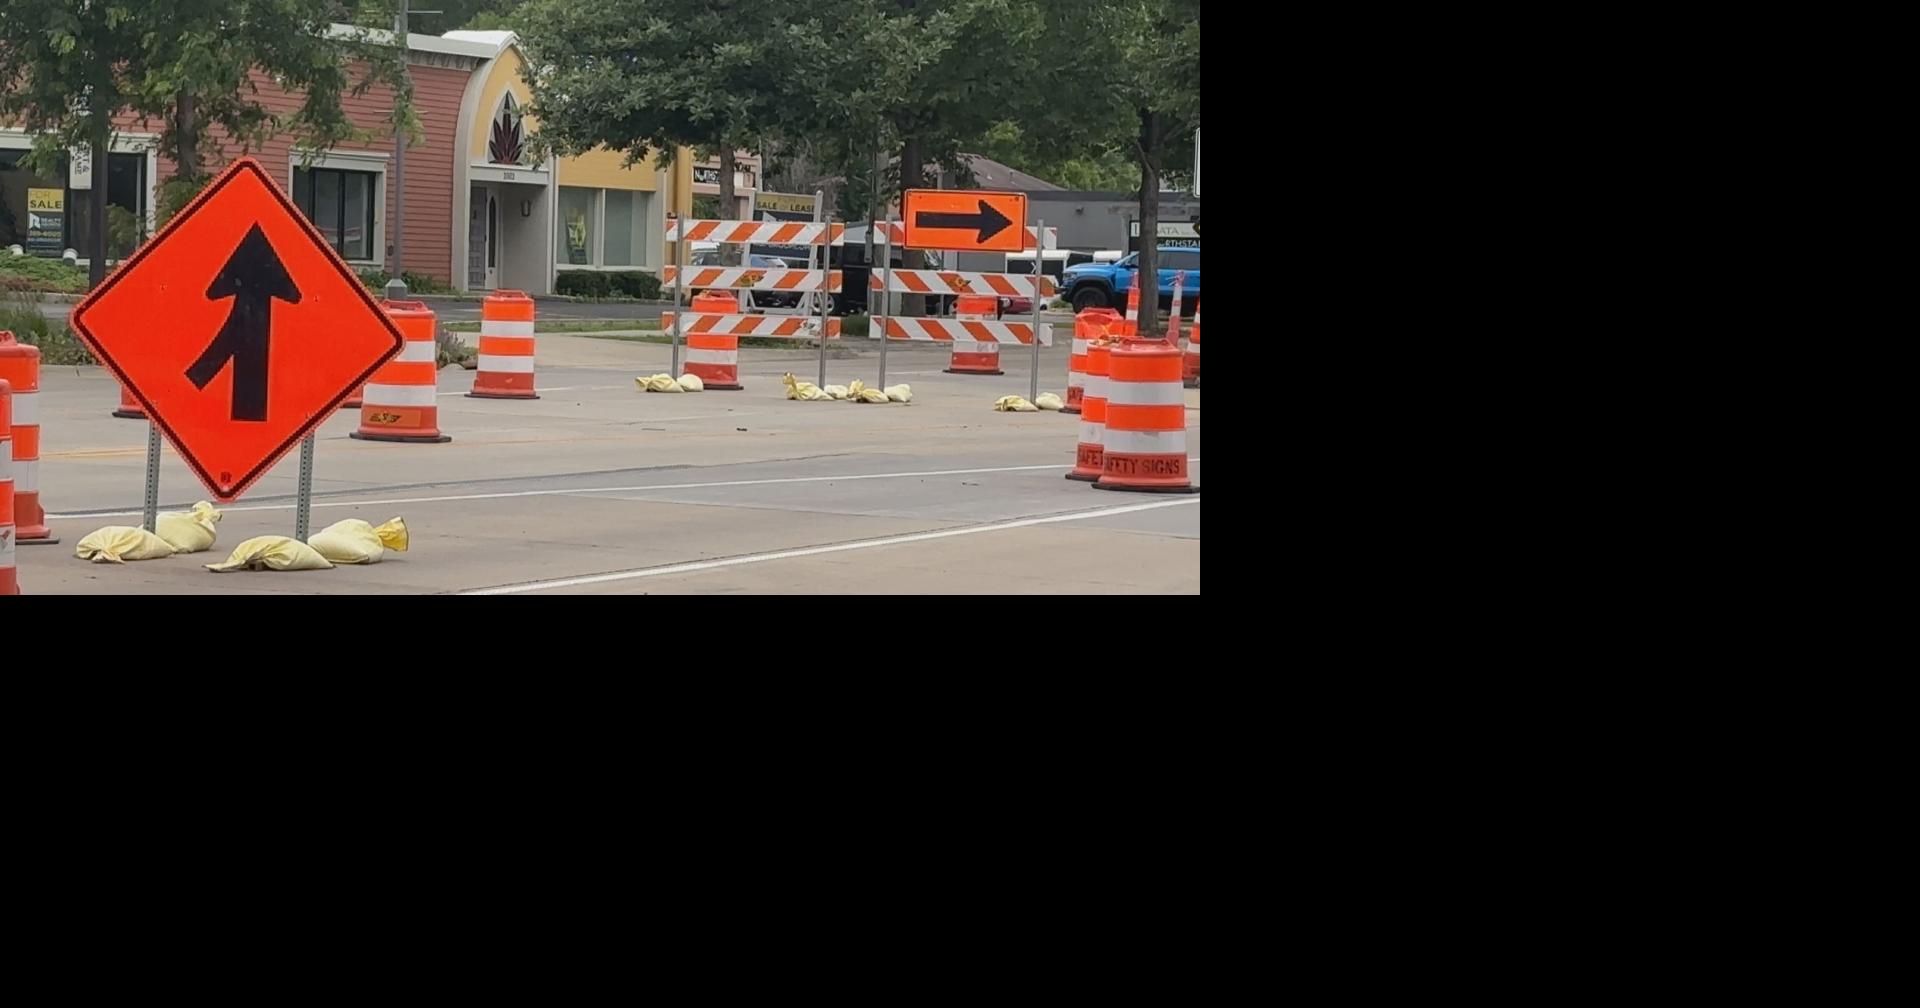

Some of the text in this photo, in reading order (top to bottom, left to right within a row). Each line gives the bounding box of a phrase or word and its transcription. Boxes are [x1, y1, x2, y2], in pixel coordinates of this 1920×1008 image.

[30, 200, 62, 209] SALE
[757, 201, 777, 209] SALE
[1142, 459, 1180, 475] SIGNS
